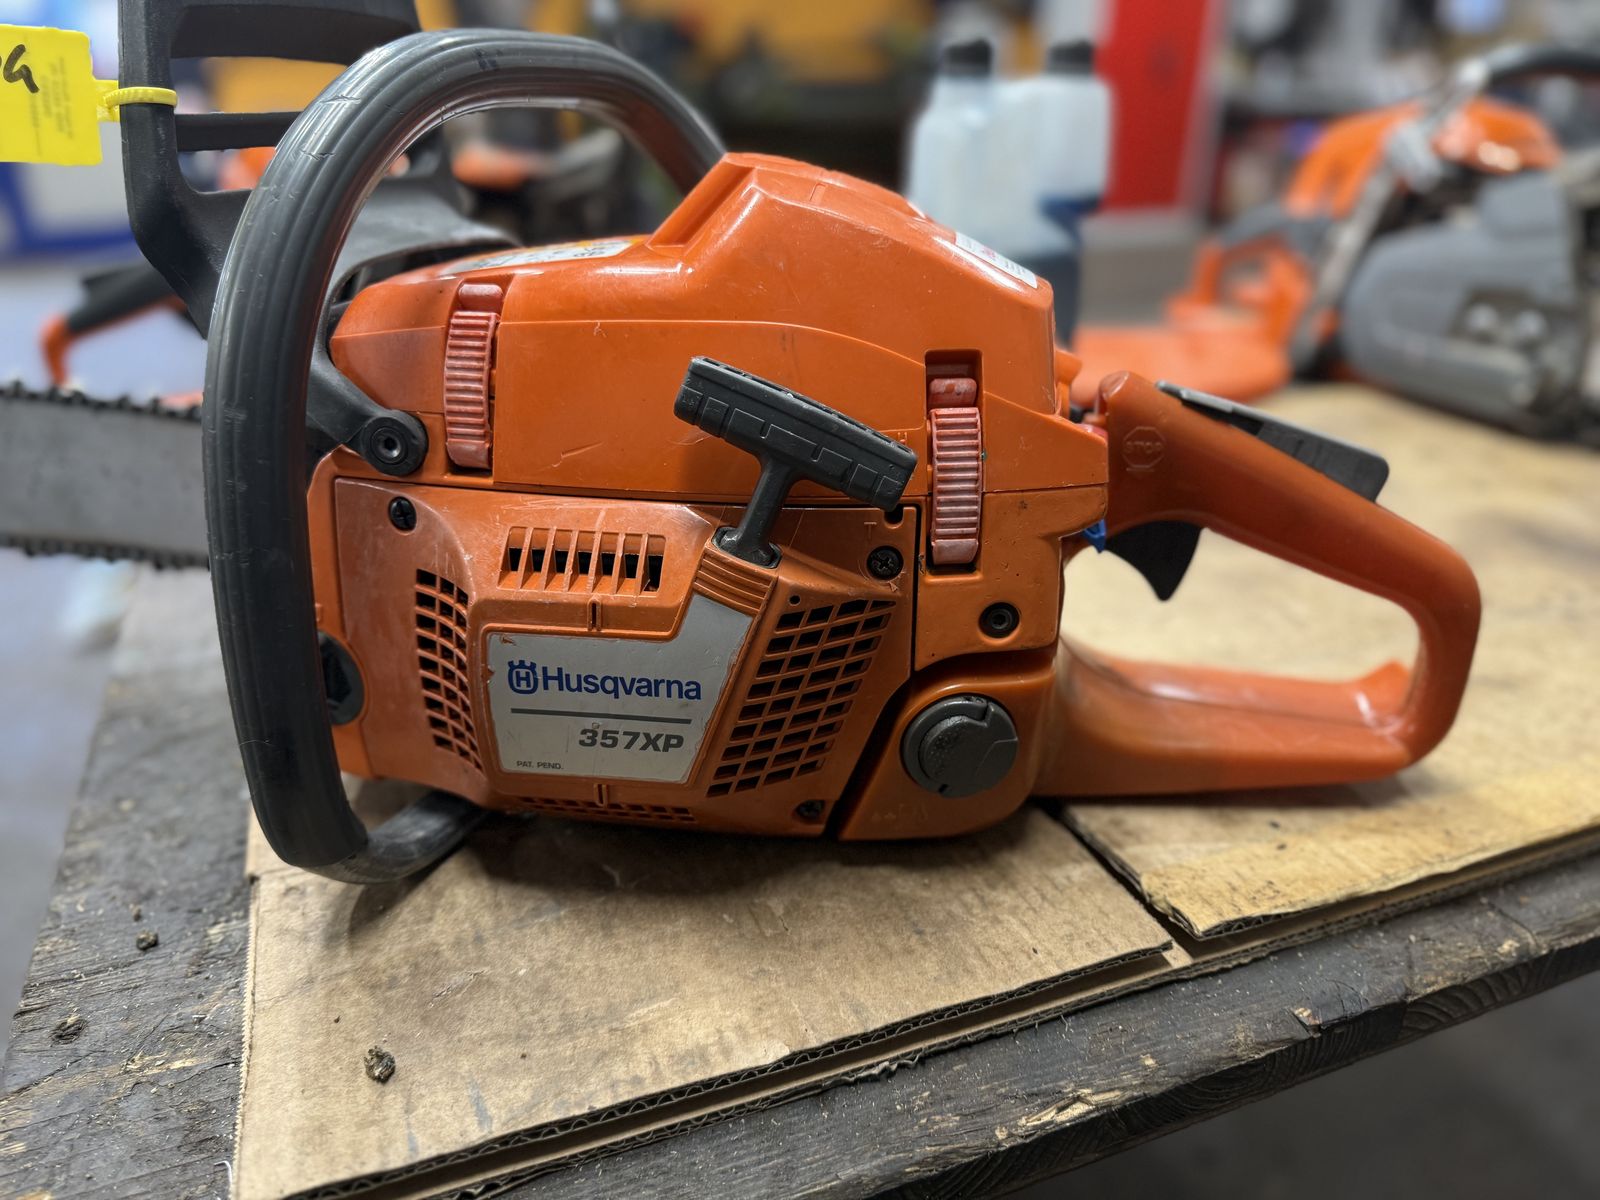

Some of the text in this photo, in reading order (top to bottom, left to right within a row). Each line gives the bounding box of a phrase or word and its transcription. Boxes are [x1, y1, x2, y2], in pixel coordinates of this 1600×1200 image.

[541, 665, 702, 701] Husqvarna
[578, 728, 684, 753] 357XP
[516, 760, 564, 770] PAT. PEND.
